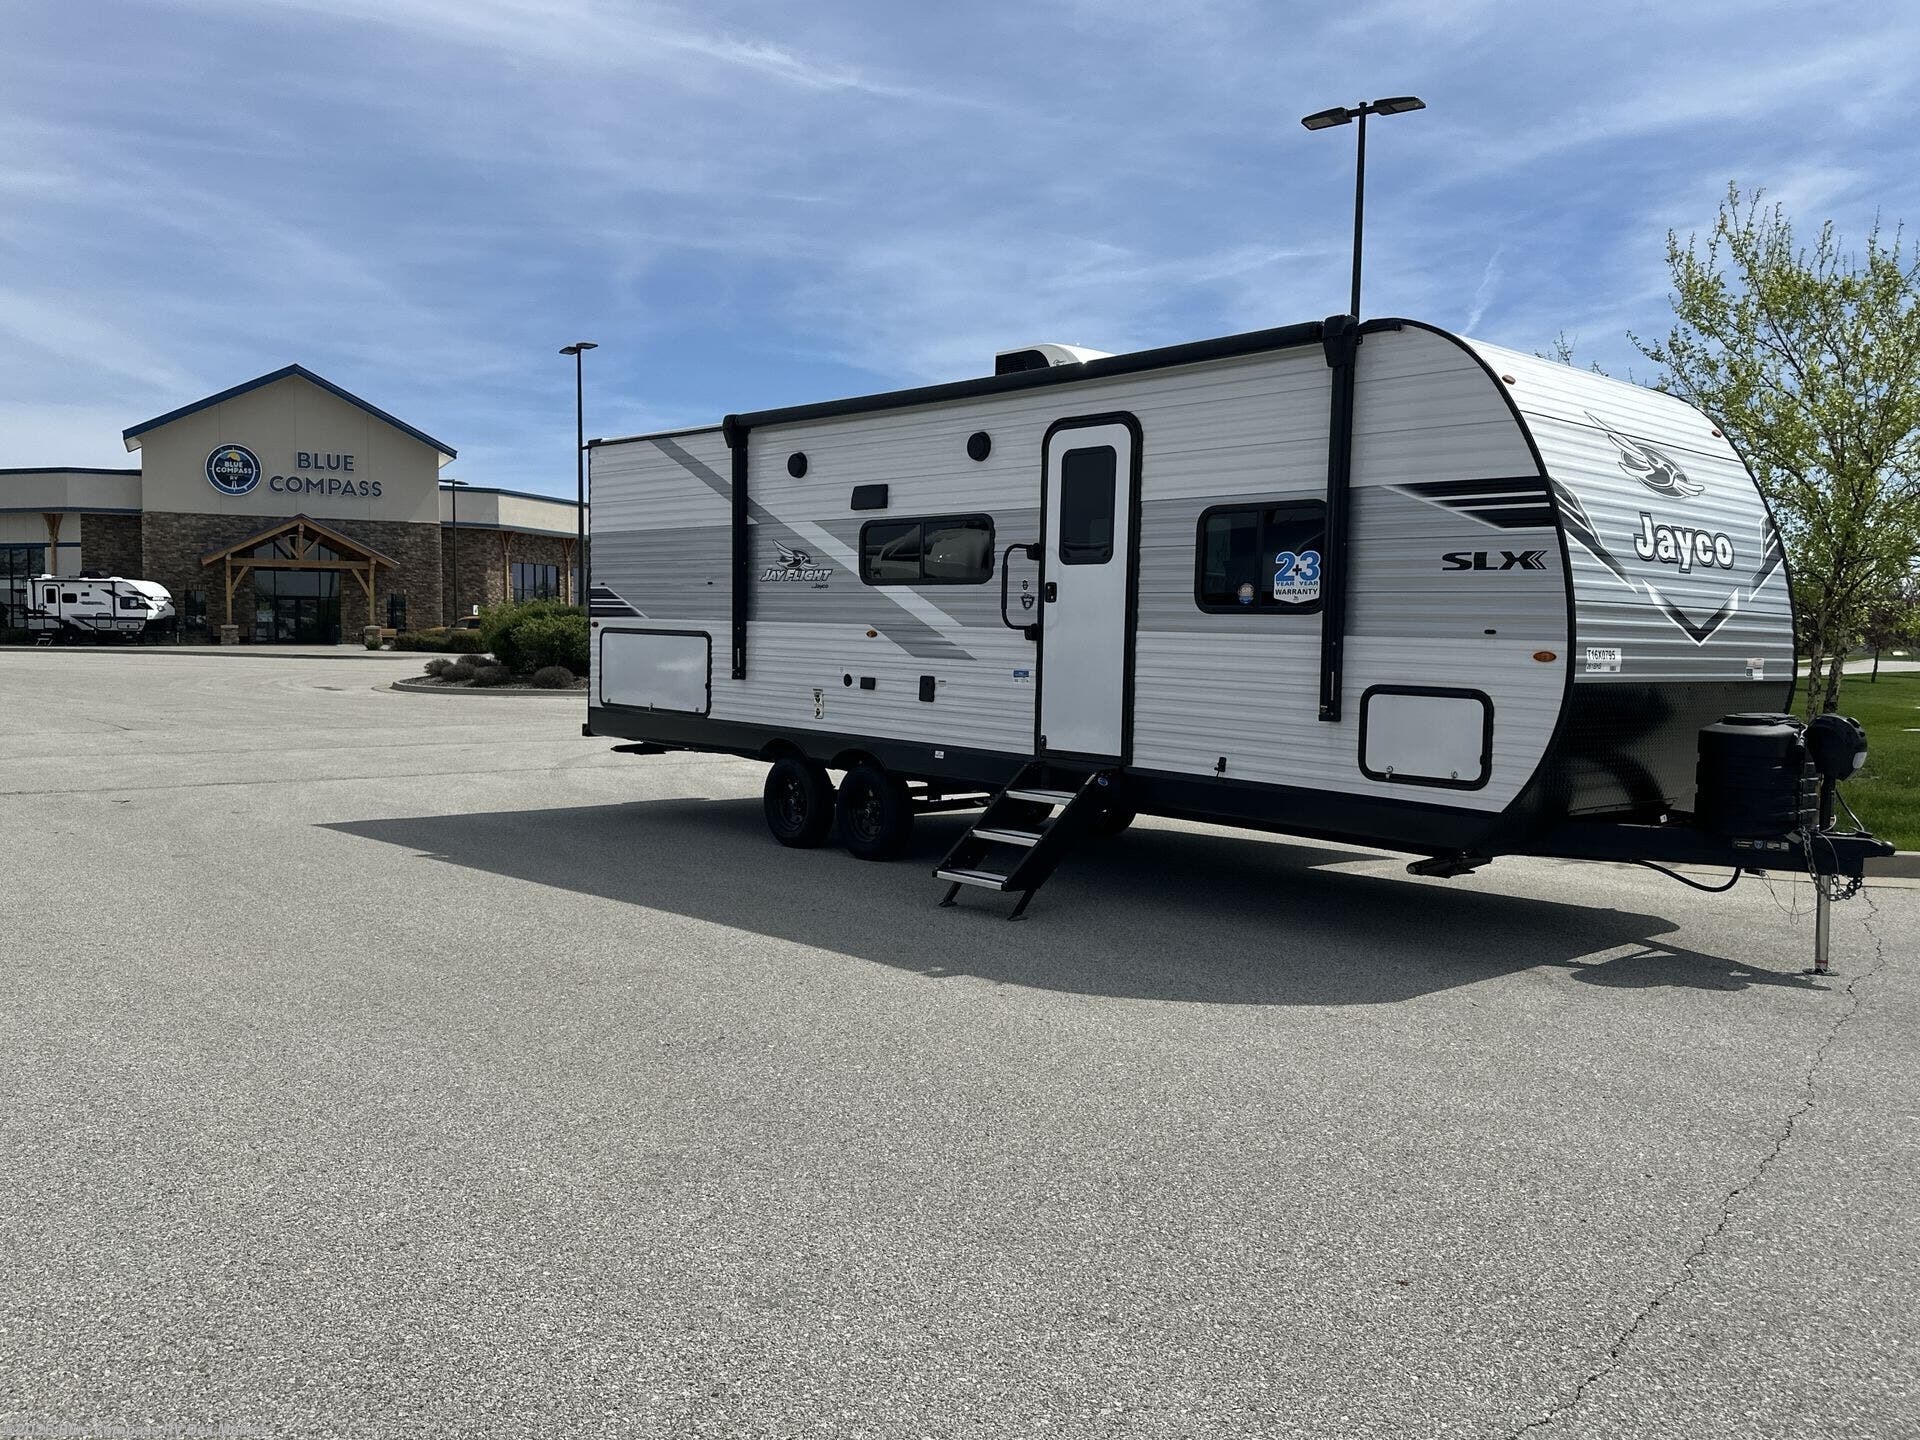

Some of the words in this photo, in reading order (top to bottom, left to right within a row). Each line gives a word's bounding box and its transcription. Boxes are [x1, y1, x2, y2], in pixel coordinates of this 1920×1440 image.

[215, 466, 252, 474] COMPASS
[297, 451, 355, 472] BLUE
[269, 475, 382, 497] COMPASS
[1633, 511, 1735, 574] Jayco
[1442, 550, 1548, 571] SLX
[760, 568, 786, 582] JAY
[784, 568, 833, 582] FLIGHT
[1275, 588, 1318, 596] WARRANTY
